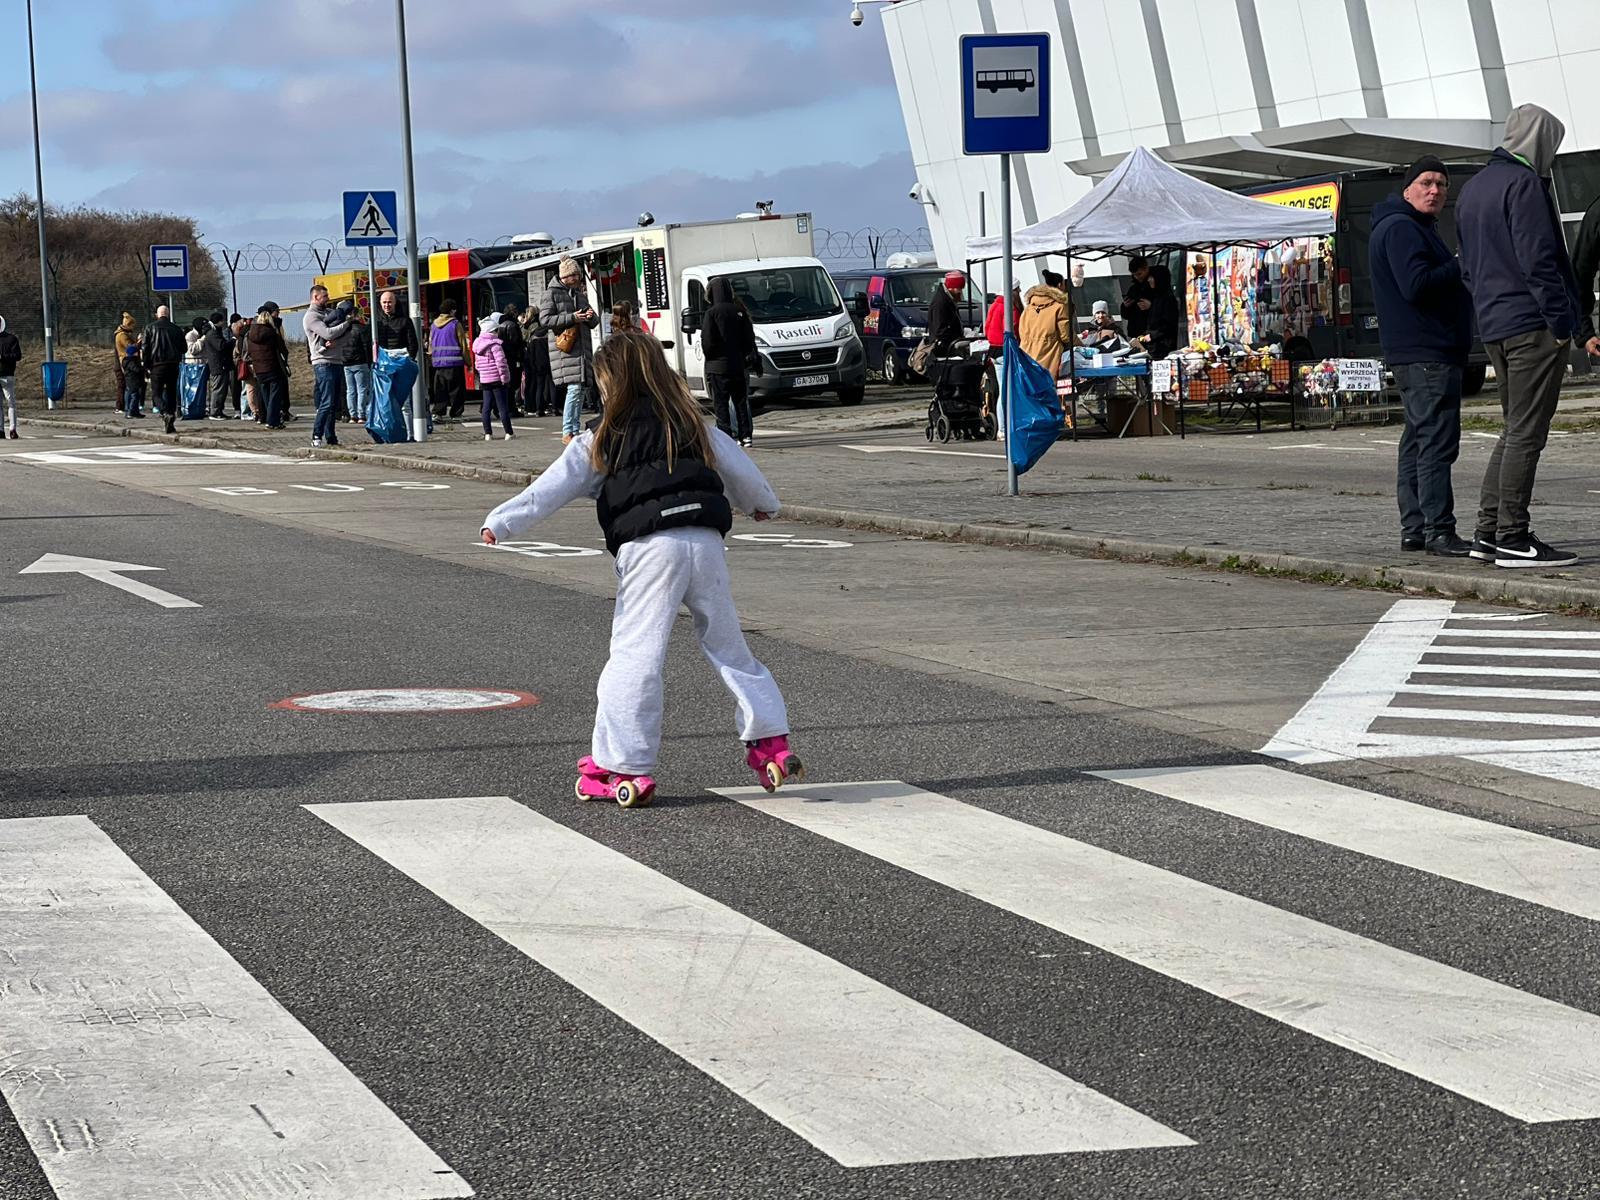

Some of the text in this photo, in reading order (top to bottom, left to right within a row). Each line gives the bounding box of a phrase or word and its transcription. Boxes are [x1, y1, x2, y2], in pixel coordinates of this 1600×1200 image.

[773, 324, 823, 340] Rastelli
[200, 481, 450, 496] BUS
[472, 533, 854, 558] BS
